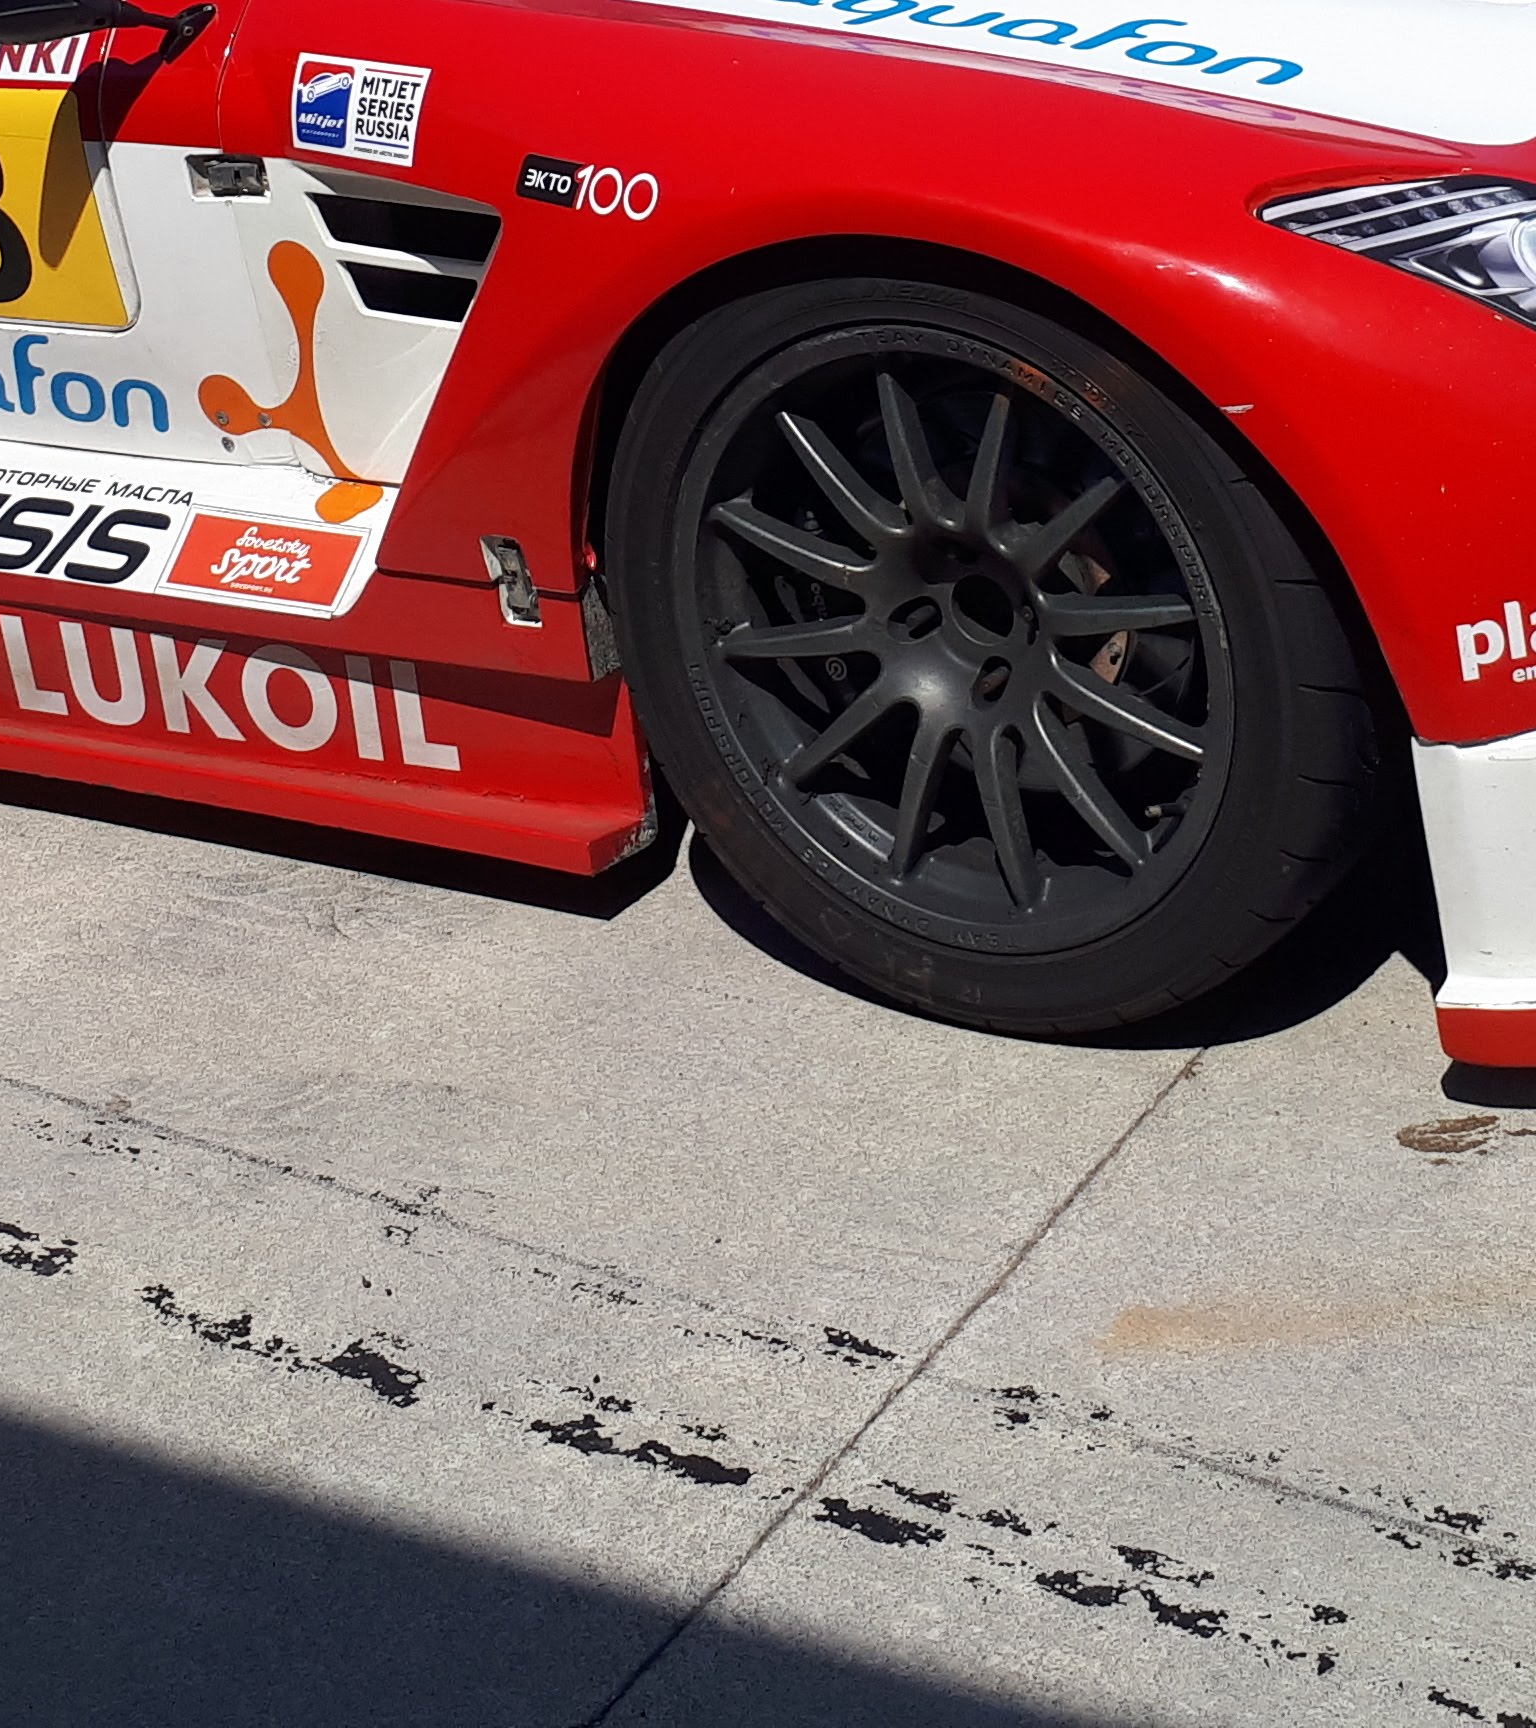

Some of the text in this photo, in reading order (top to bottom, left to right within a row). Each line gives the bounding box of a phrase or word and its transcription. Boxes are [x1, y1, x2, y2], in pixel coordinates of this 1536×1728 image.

[360, 76, 421, 101] MITJET
[357, 97, 415, 121] SERIES
[355, 118, 410, 142] RUSSIA
[574, 163, 659, 221] 100
[105, 481, 194, 507] МАСЛА
